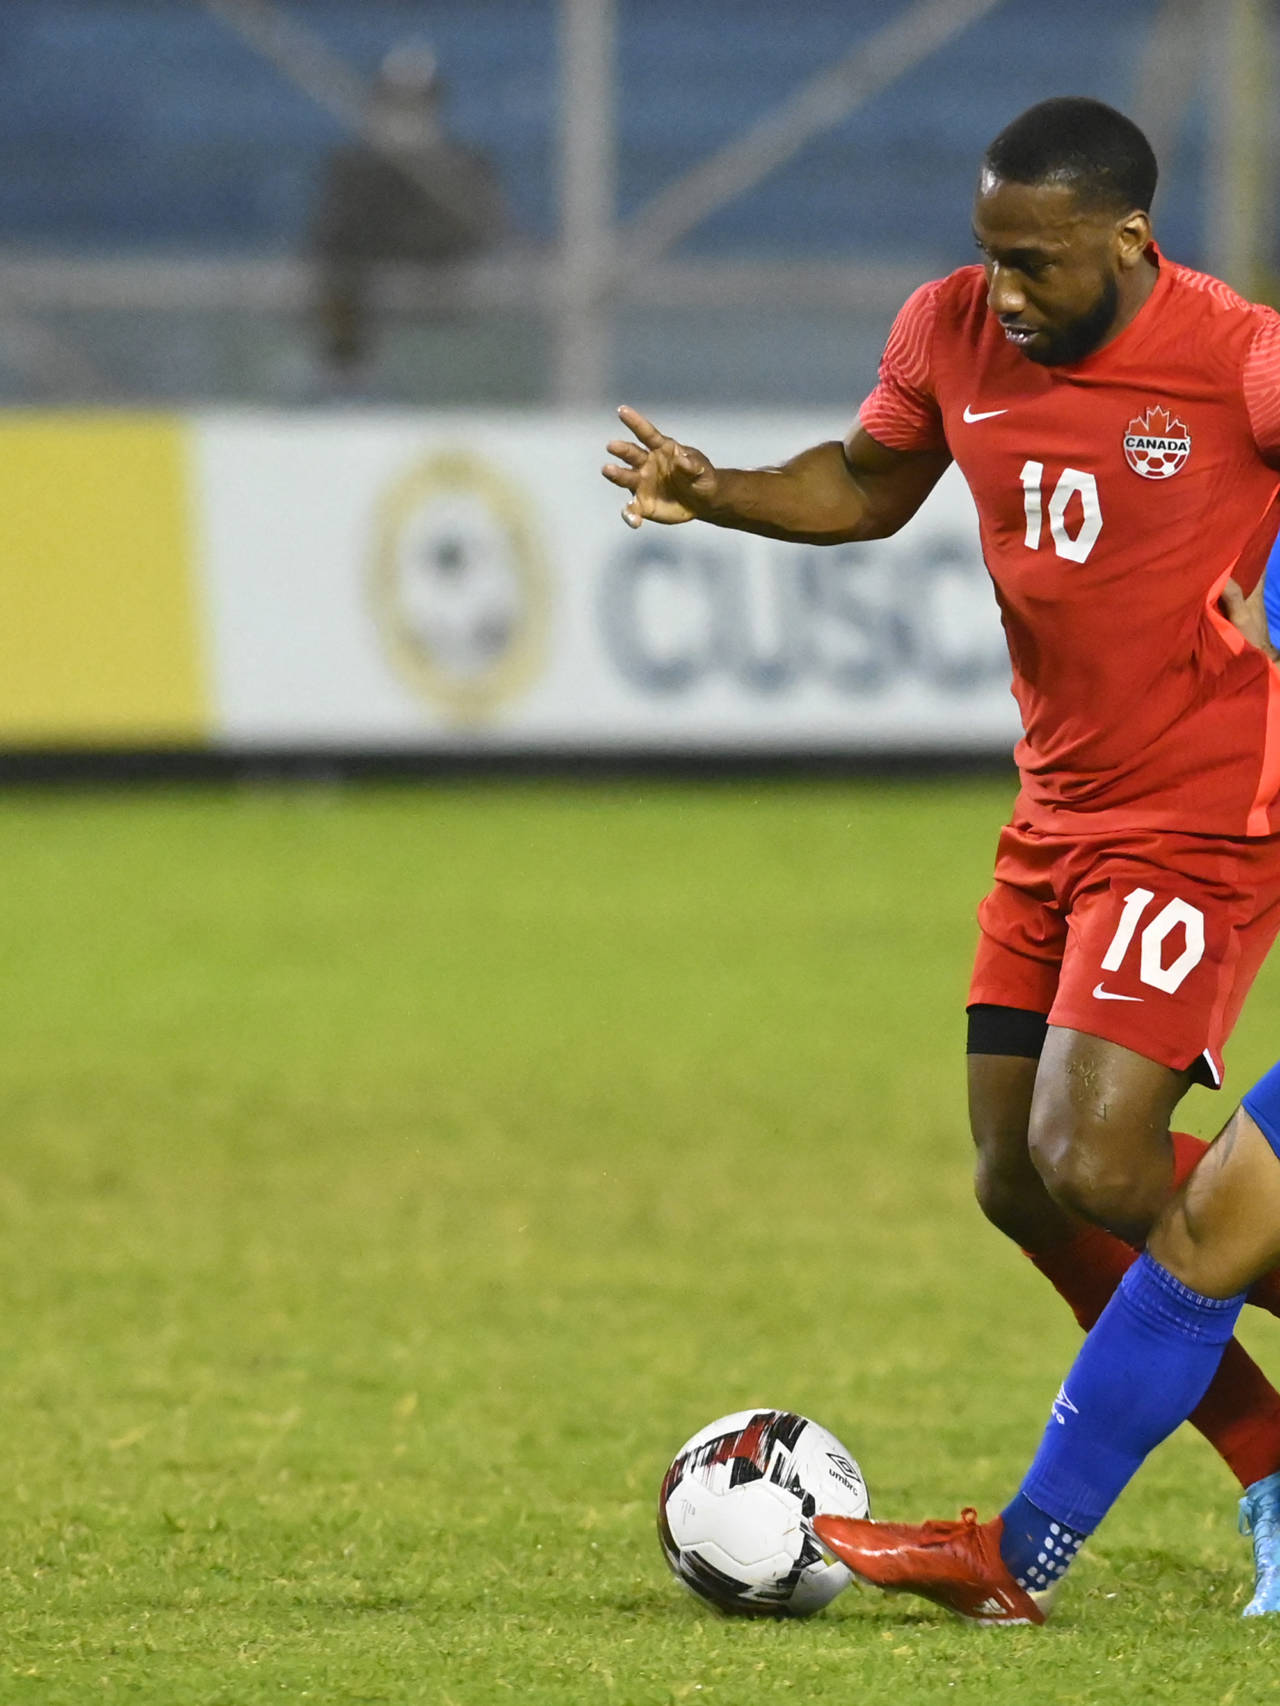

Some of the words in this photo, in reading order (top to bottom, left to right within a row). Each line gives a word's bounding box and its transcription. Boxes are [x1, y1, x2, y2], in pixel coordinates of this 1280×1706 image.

[1125, 437, 1188, 452] CANADA
[1019, 460, 1104, 564] 10
[1100, 887, 1206, 995] 10
